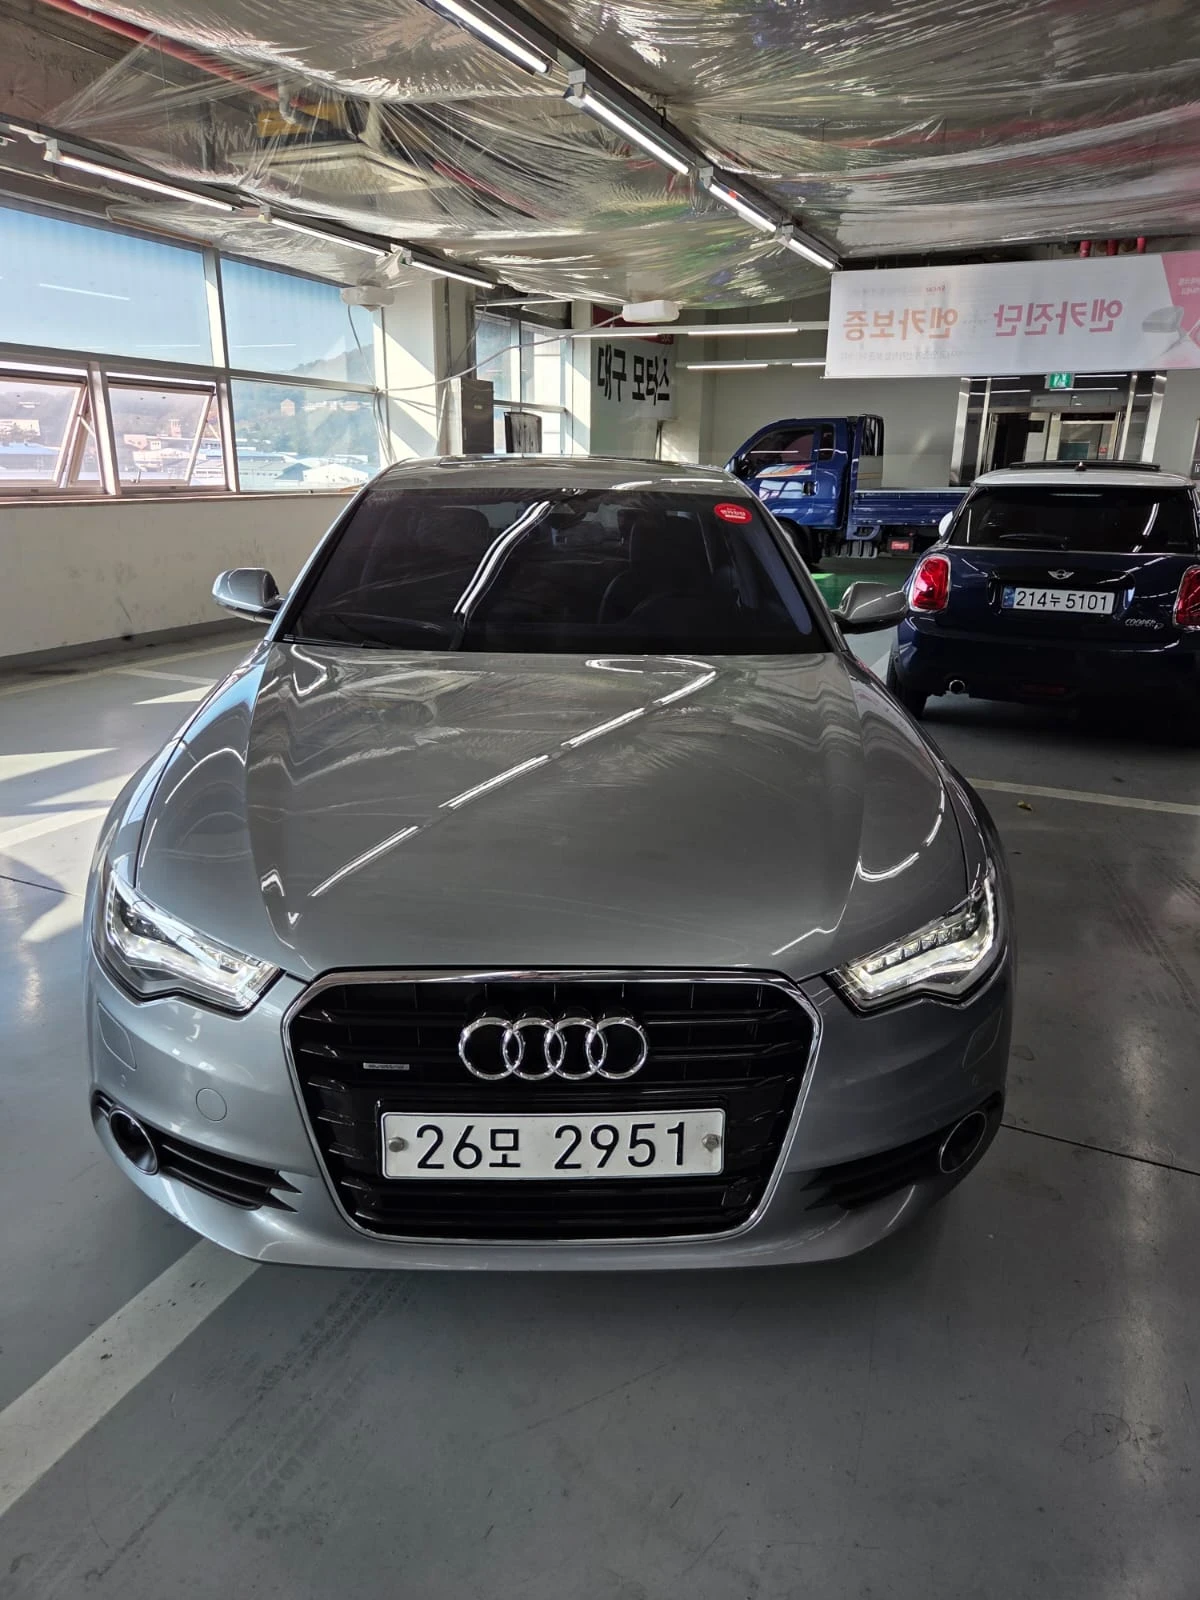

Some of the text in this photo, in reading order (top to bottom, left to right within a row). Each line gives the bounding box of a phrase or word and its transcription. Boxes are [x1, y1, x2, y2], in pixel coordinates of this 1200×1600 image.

[598, 344, 670, 405] 대구 모터스
[1016, 590, 1108, 611] 214누 5101
[416, 1121, 685, 1169] 26모 2951
